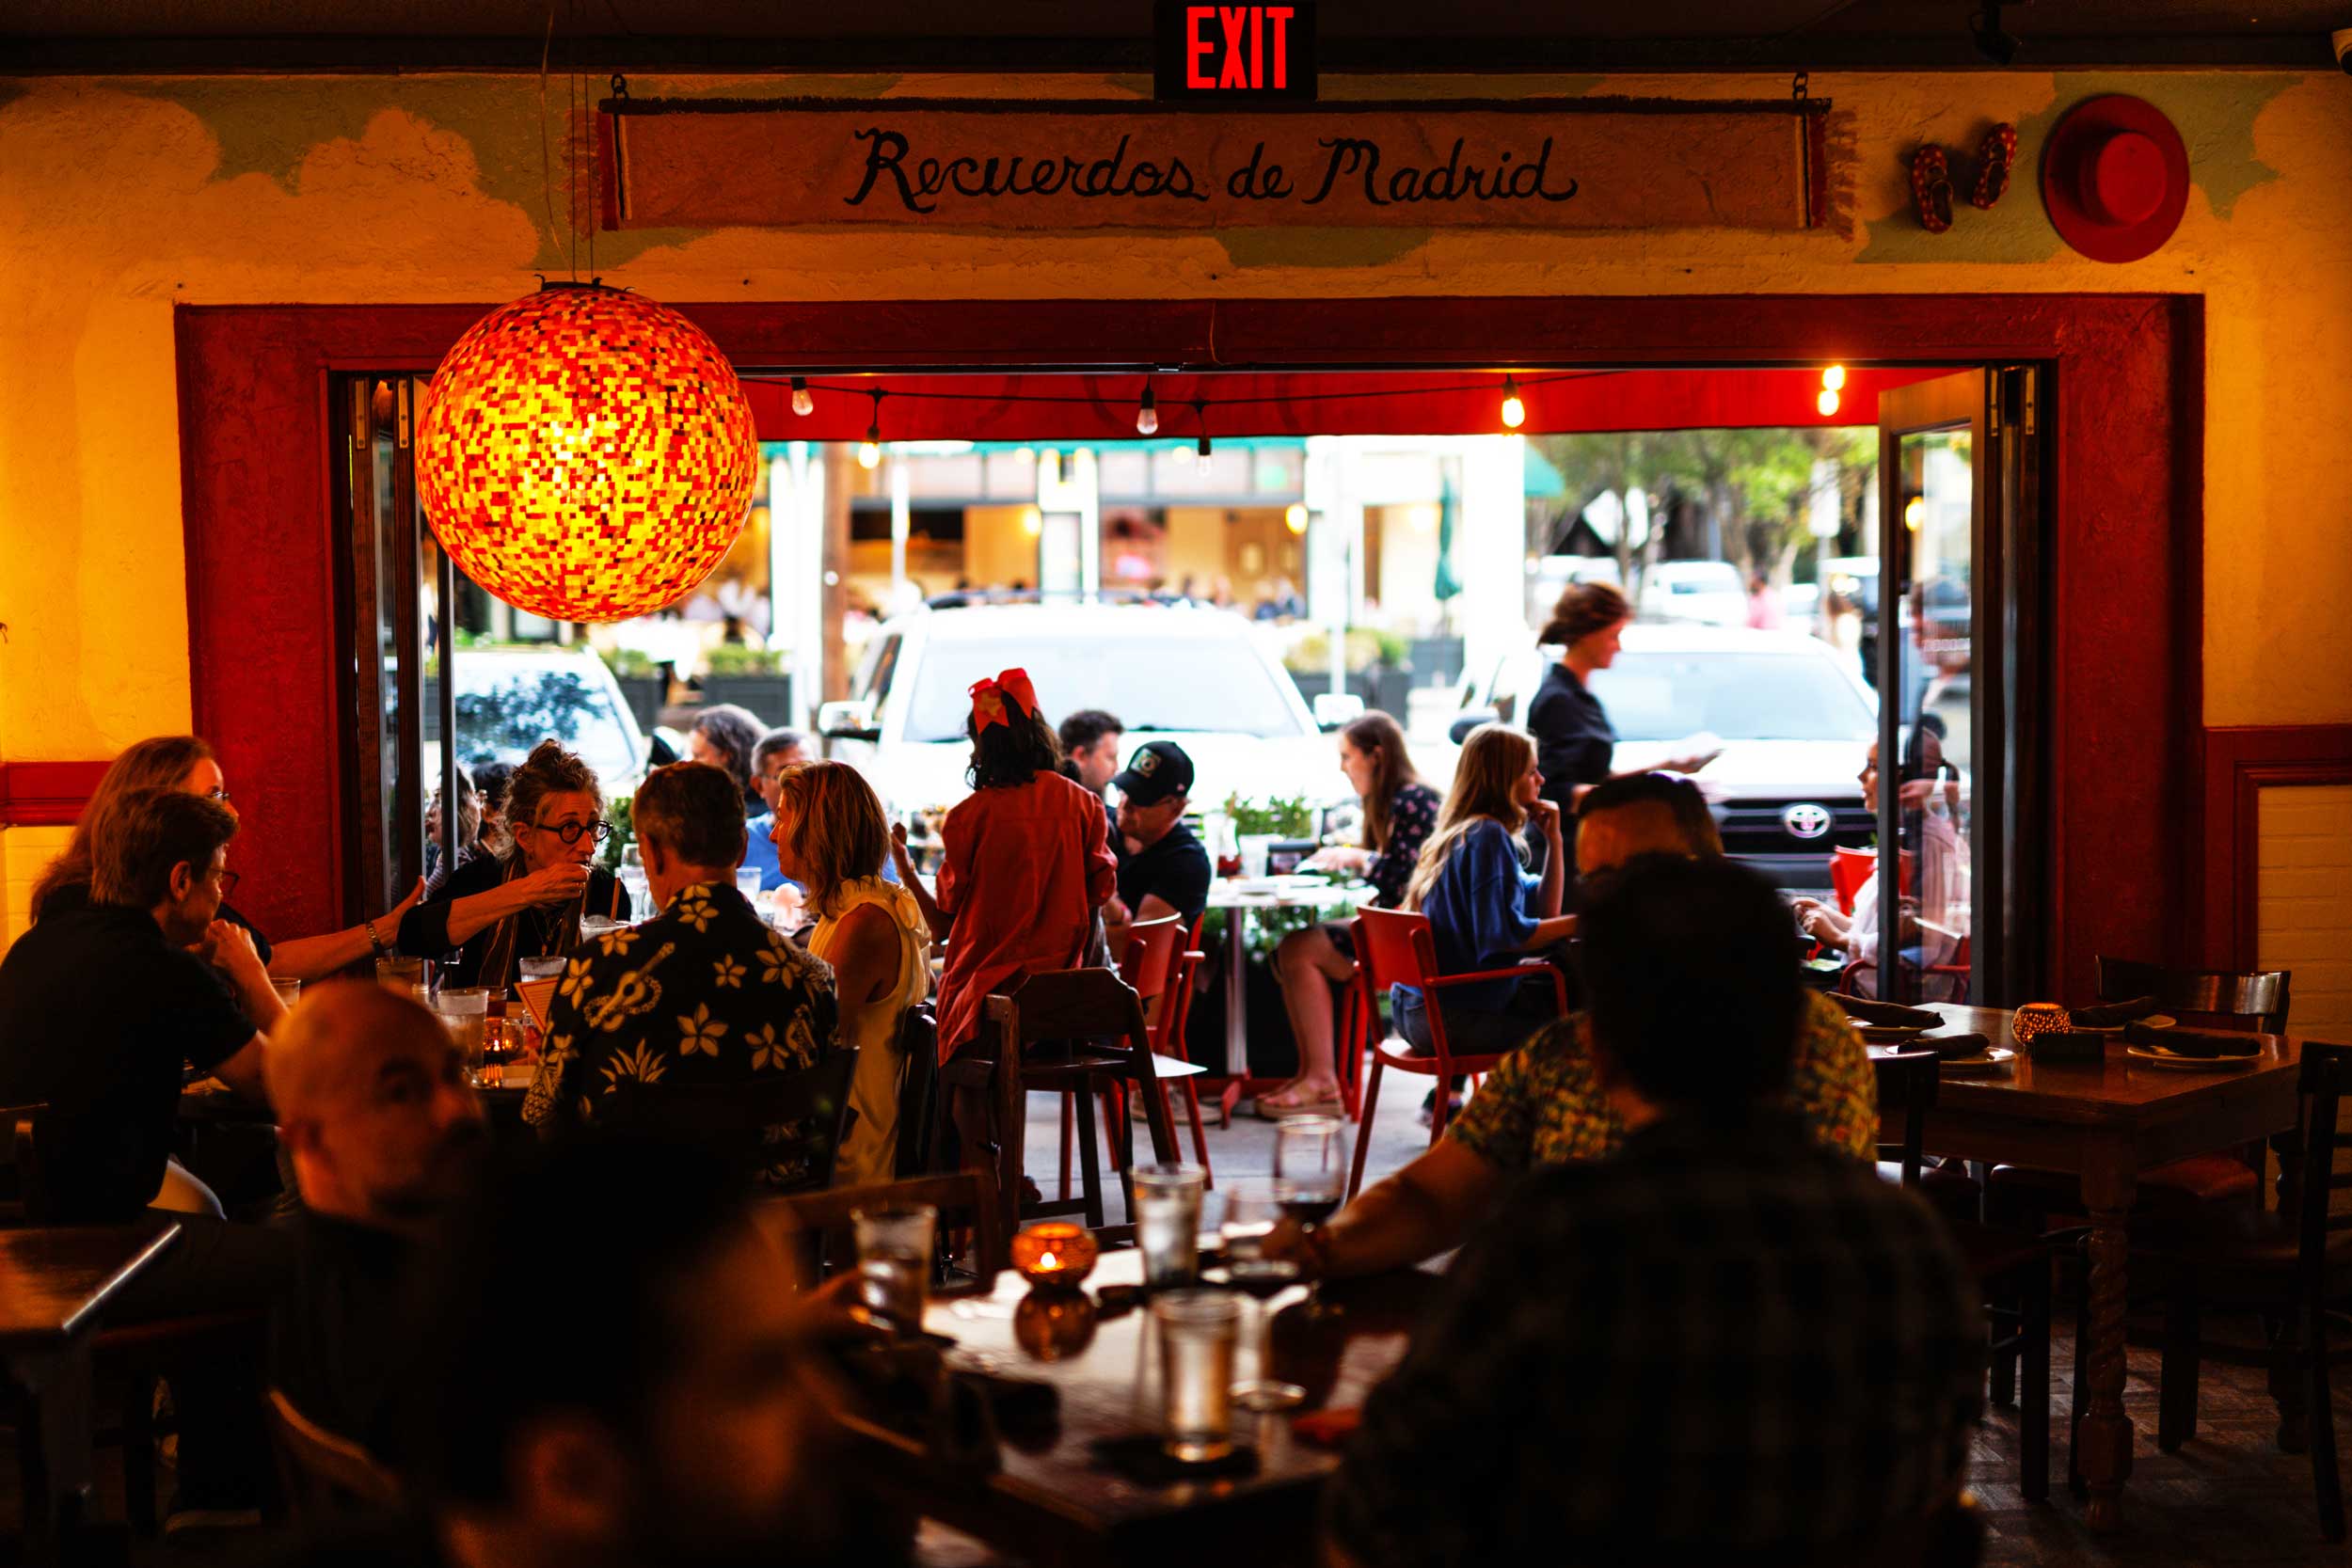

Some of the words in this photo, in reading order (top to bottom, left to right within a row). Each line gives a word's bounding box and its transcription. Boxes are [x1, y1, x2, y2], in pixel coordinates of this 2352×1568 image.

[1186, 7, 1295, 88] EXIT
[844, 127, 1211, 214] Recuerdos
[1227, 141, 1294, 199] de
[1302, 135, 1578, 205] Madrid
